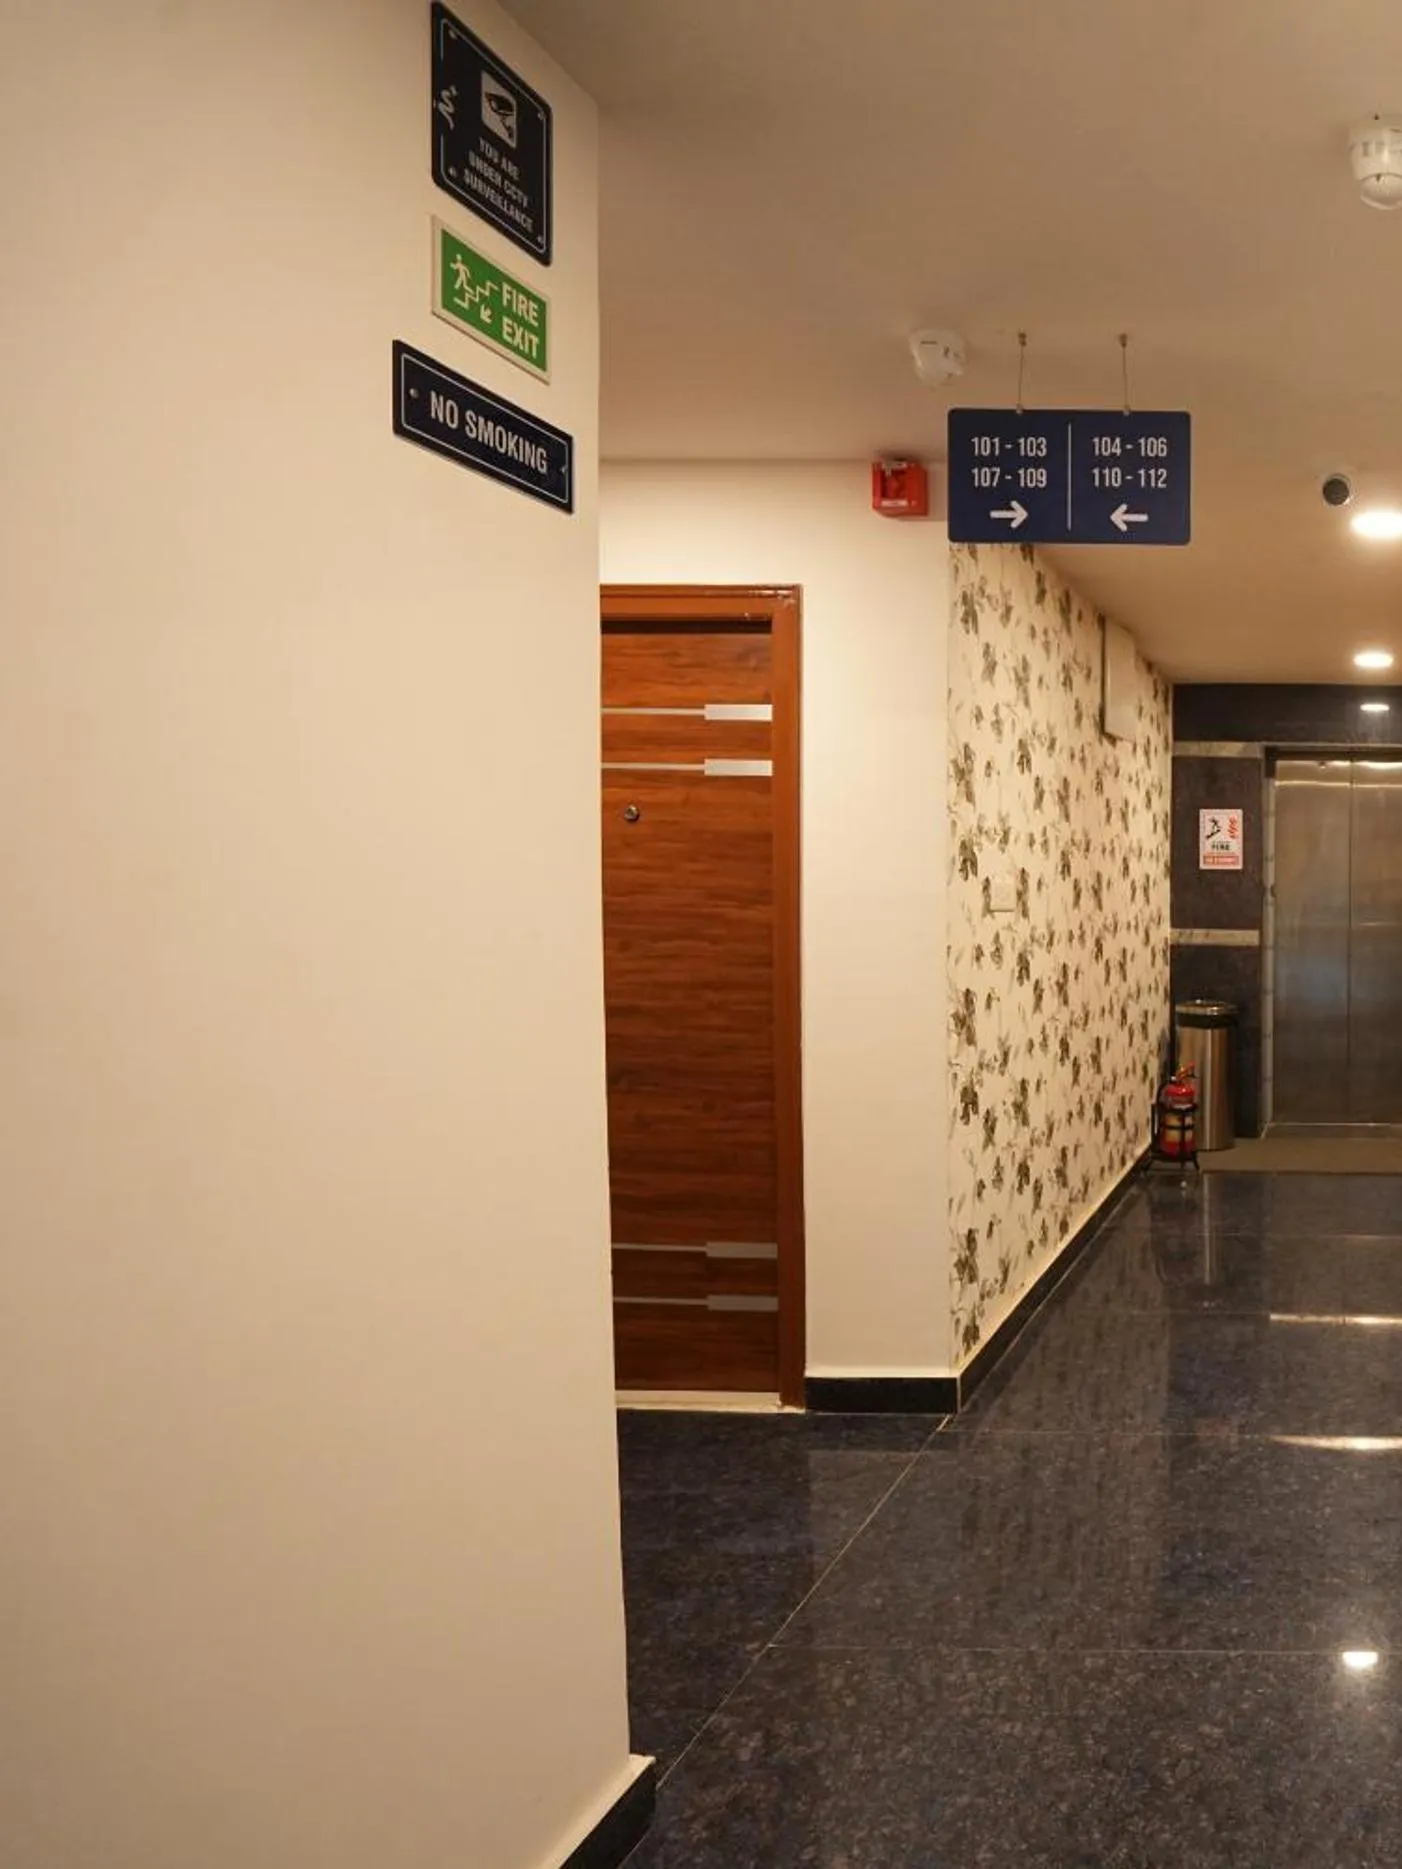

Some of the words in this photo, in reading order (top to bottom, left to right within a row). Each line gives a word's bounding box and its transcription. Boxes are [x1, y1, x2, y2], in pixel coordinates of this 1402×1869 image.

[468, 149, 502, 188] UNDER
[503, 179, 528, 208] CCTV
[479, 137, 500, 164] YOU
[501, 156, 520, 181] ARE
[463, 168, 533, 233] SURVEILLANCE
[501, 280, 539, 328] FIRE
[501, 317, 540, 360] EXIT
[429, 390, 458, 430] NO
[464, 410, 549, 475] SMOKING
[971, 436, 1000, 456] 101
[1018, 436, 1047, 456] 103
[1092, 436, 1121, 456] 104
[1138, 436, 1167, 456] 106
[971, 467, 1000, 488] 107
[1018, 467, 1047, 488] 109
[1092, 467, 1121, 488] 110
[1138, 467, 1167, 488] 112
